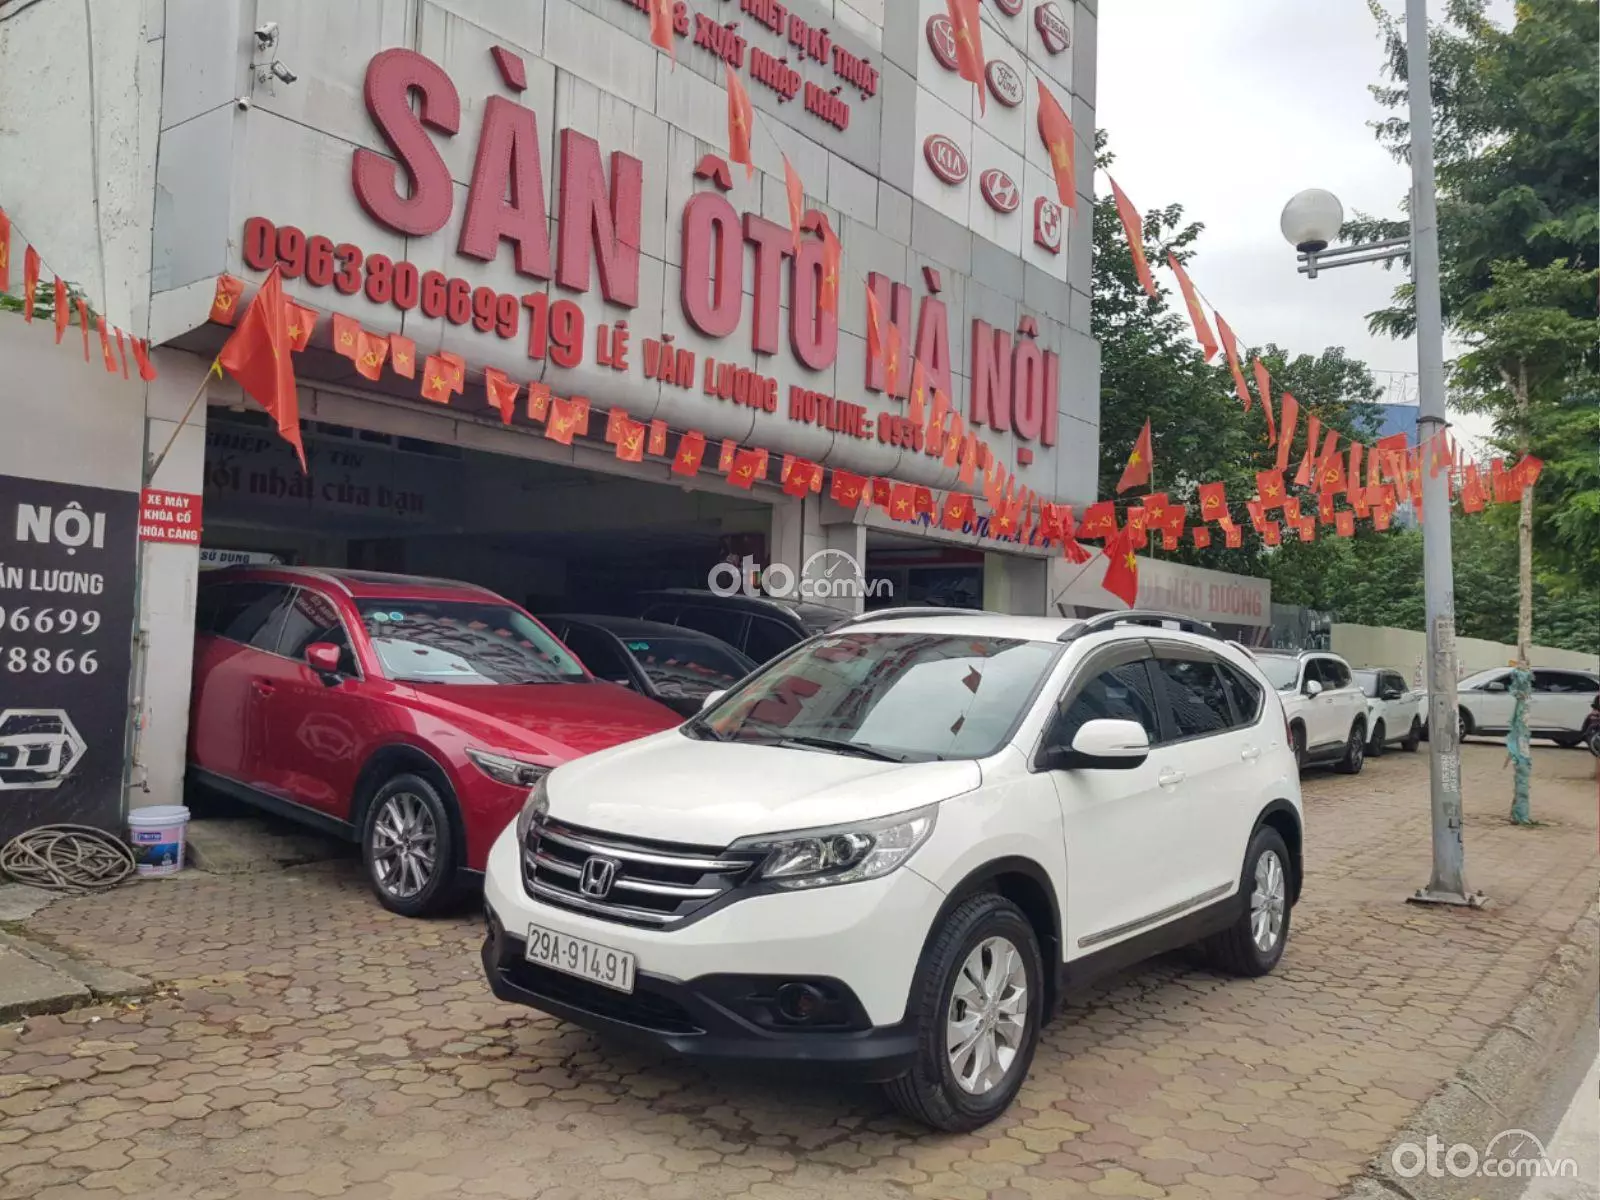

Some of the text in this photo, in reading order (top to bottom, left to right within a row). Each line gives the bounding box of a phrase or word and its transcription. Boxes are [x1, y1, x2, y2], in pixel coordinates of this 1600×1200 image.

[694, 13, 747, 68] XUẤT
[750, 47, 802, 104] NHẬP
[804, 85, 849, 131] KHẨU
[832, 44, 879, 101] THUẬT
[351, 45, 1060, 465] SÀN ÔTÔ HÀ NỘI
[642, 333, 695, 389] VĂN
[704, 357, 778, 412] LƯƠNG
[789, 385, 874, 439] HOTLINE:
[147, 494, 161, 505] XE
[16, 501, 106, 556] NỘI
[30, 568, 104, 595] LƯƠNG
[529, 929, 628, 986] 29A-914.91
